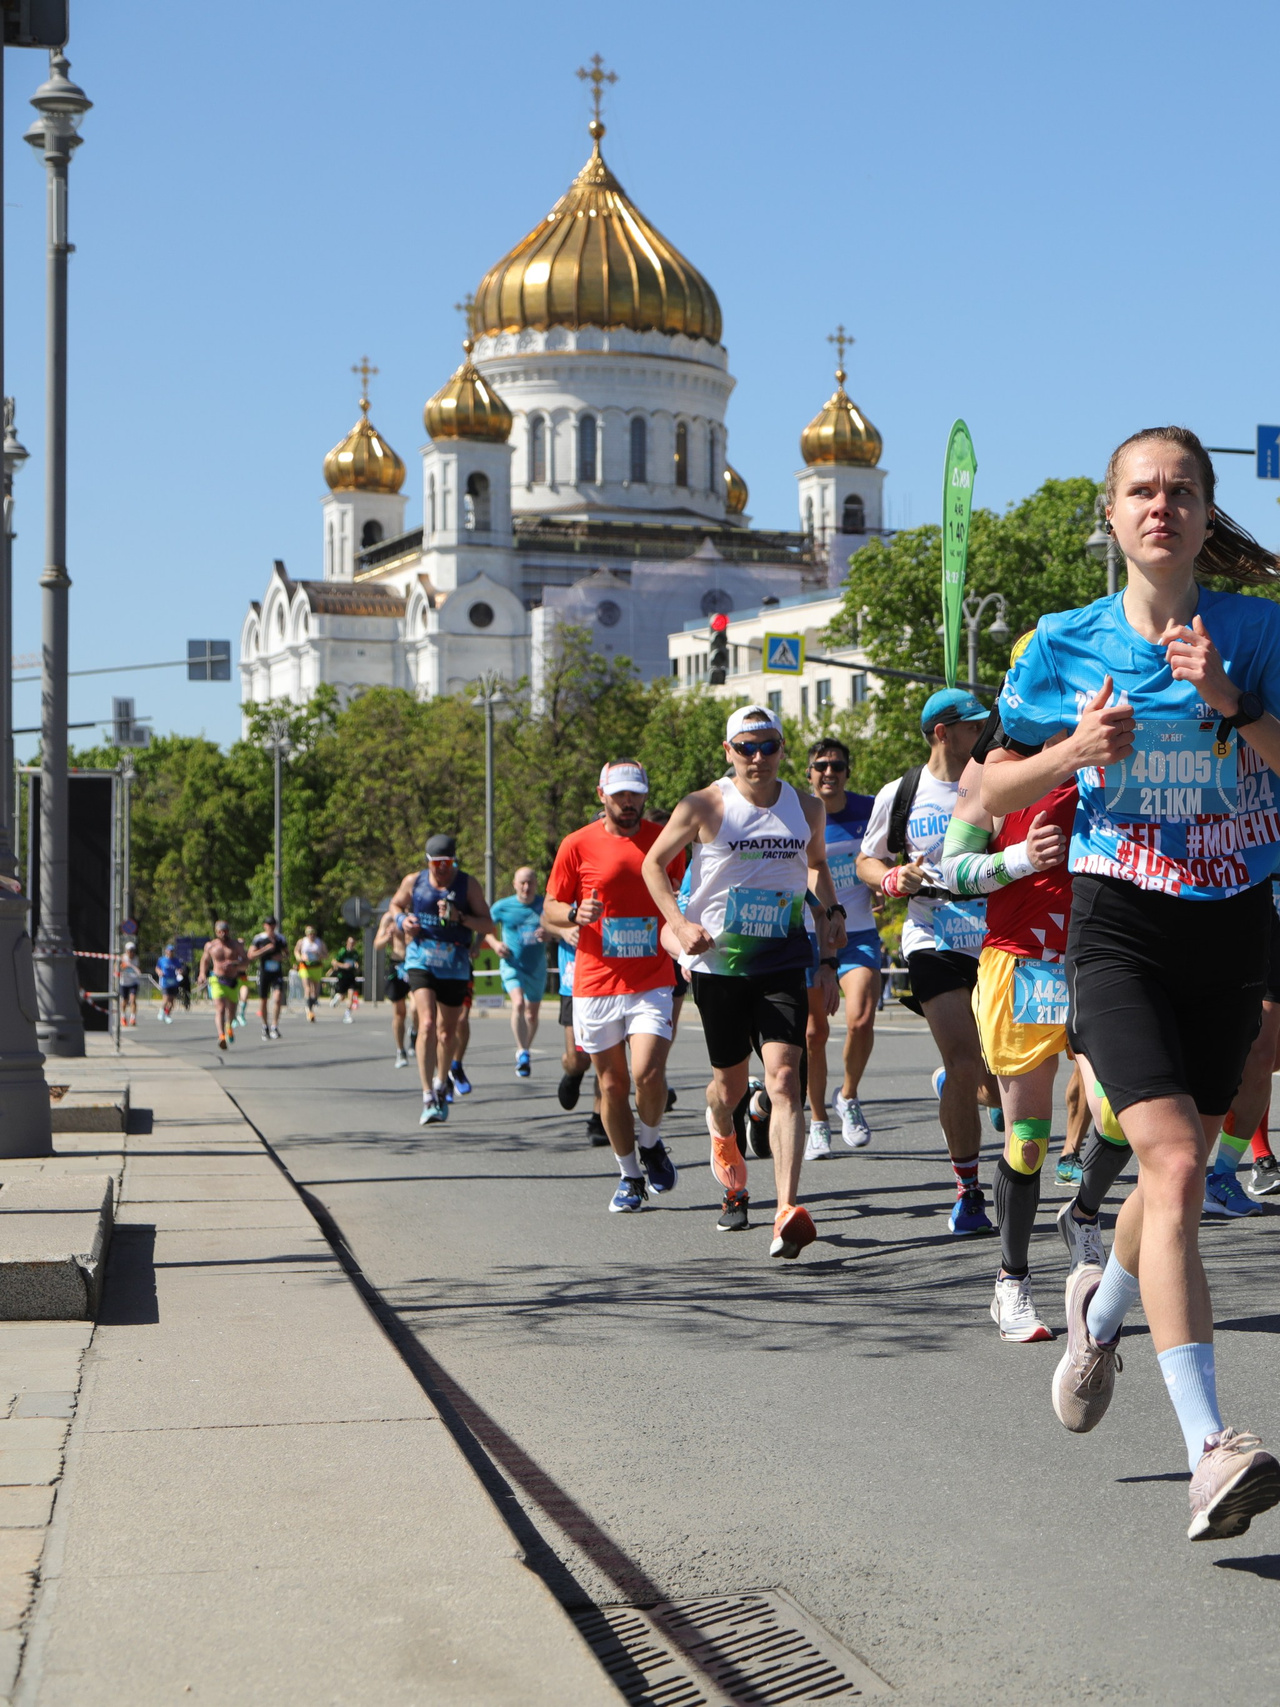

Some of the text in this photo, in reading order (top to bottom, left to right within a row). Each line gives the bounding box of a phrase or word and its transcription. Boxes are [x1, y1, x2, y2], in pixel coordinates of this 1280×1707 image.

[1002, 674, 1023, 709] СБ
[1131, 750, 1211, 783] 40105
[1140, 787, 1202, 814] 21.1KM
[1237, 772, 1275, 813] 024
[728, 838, 805, 851] УРАЛХИМ
[831, 862, 855, 878] 3487
[740, 903, 779, 922] 43781
[612, 930, 648, 944] 40092
[740, 921, 773, 937] 21.1KM
[952, 933, 983, 949] 21.1KM
[1032, 980, 1069, 1002] 442
[1036, 1005, 1068, 1024] 21.1K
